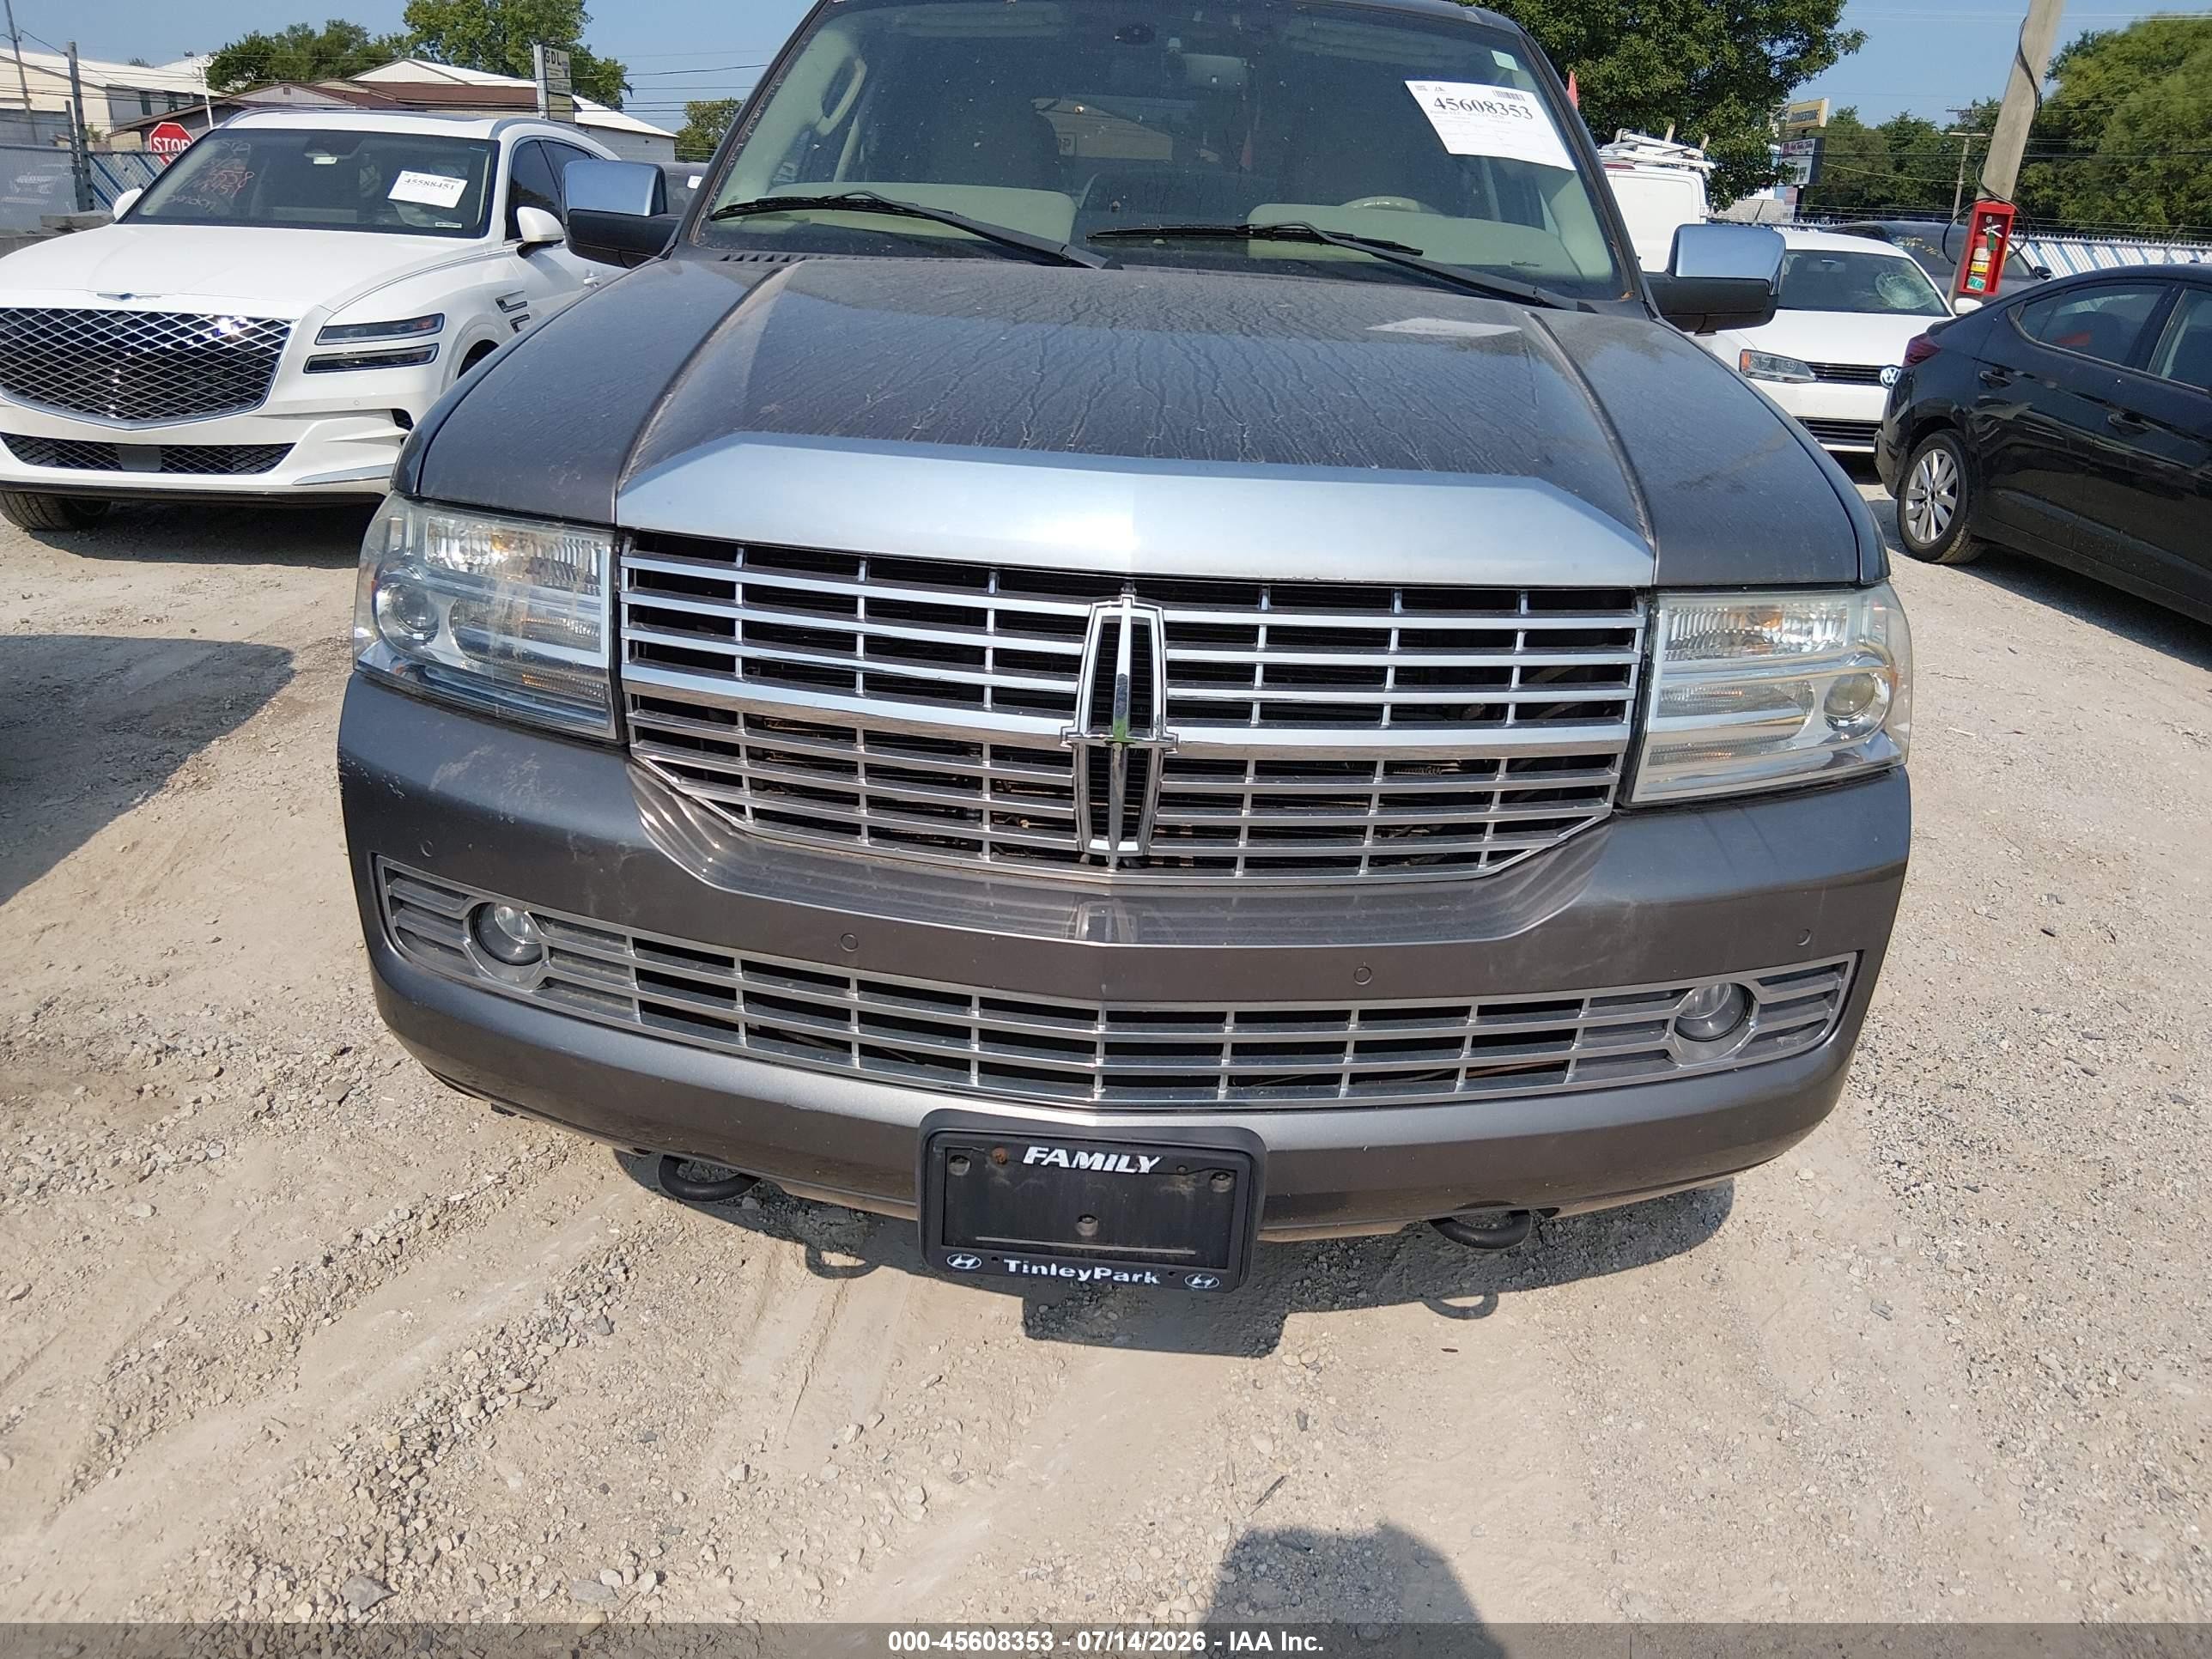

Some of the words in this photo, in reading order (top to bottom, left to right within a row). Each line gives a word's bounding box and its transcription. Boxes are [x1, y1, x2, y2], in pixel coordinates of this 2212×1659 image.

[1433, 97, 1534, 120] 45608353
[153, 137, 191, 153] STOP
[1023, 1146, 1163, 1174] FAMILY
